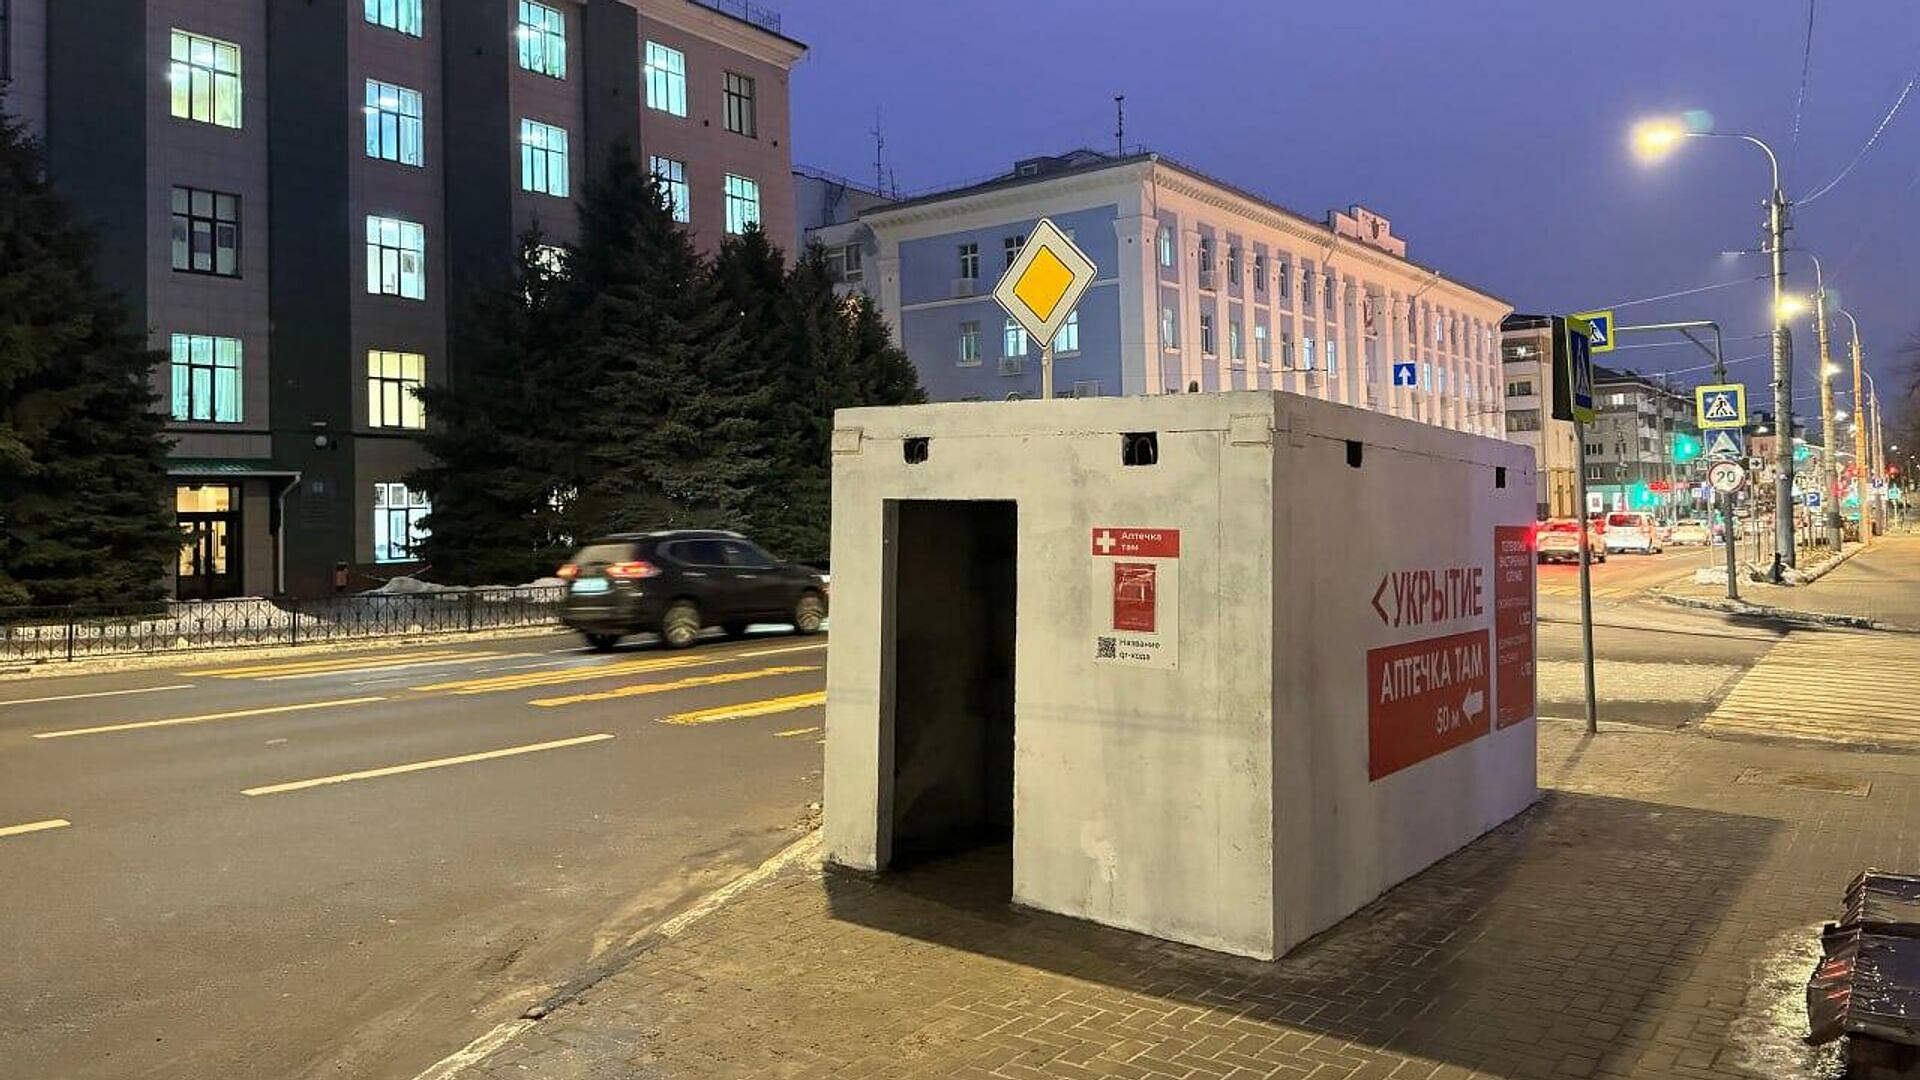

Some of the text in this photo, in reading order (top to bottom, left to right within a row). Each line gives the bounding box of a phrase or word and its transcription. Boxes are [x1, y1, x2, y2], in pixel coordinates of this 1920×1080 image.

[1717, 471, 1736, 483] 20
[1121, 531, 1162, 542] Аптечка
[1393, 567, 1483, 628] УКРЫТИЕ
[1119, 640, 1161, 650] Название
[1380, 643, 1484, 704] АПТЕЧКА ТАМ
[1451, 709, 1461, 729] м
